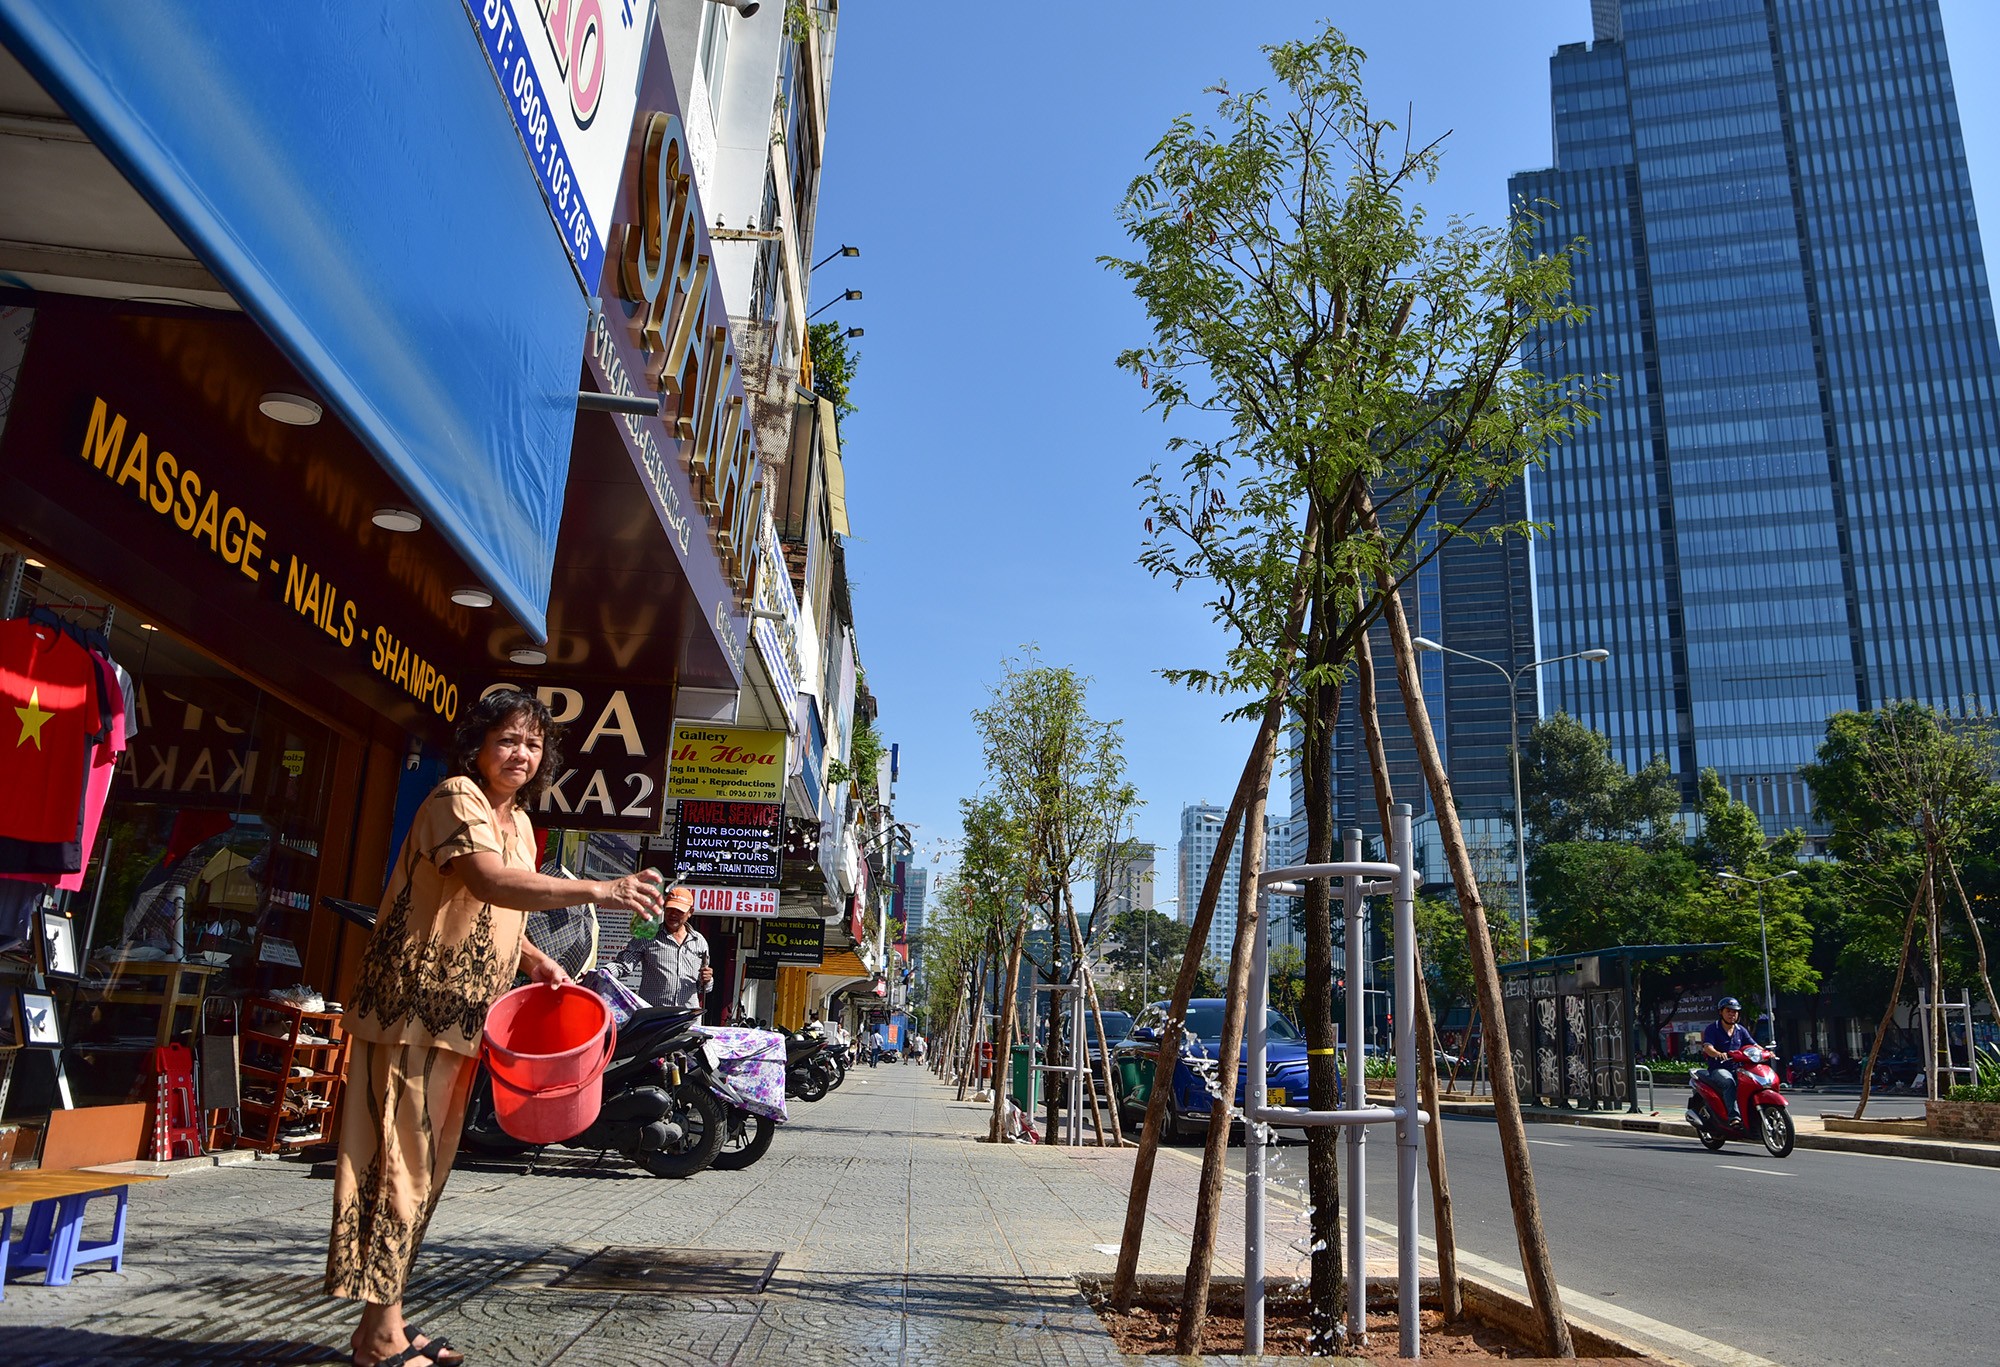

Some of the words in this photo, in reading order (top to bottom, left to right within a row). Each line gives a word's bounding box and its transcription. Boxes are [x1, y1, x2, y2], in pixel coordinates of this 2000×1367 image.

[512, 56, 593, 262] 0908.103.765
[81, 396, 266, 581] MASSAGE
[283, 554, 356, 648] NAILS
[371, 625, 458, 723] SHAMPOO
[679, 730, 728, 744] Gallery
[710, 745, 778, 765] Hoa
[686, 765, 695, 773] In
[698, 766, 748, 775] Wholesale:
[709, 777, 776, 788] Reproductions
[729, 789, 746, 797] 0936
[748, 790, 761, 798] 071
[763, 791, 777, 799] 789
[682, 800, 727, 825] TRAVEL
[729, 802, 780, 827] SERVICE
[687, 825, 718, 836] TOUR
[686, 837, 729, 848] LUXURY
[732, 839, 769, 850] TOURS
[685, 849, 731, 860] PRIVATE
[731, 851, 769, 862] TOURS
[677, 861, 691, 872] AIR
[696, 862, 713, 872] BUS
[718, 863, 741, 873] TRAIN
[743, 864, 775, 875] TICKETS
[699, 889, 733, 911] CARD
[736, 891, 750, 901] 4G
[760, 892, 774, 902] 5G
[736, 902, 774, 913] Esim
[766, 933, 788, 947] XQ
[789, 938, 802, 946] SÀI
[803, 938, 819, 946] GÒN
